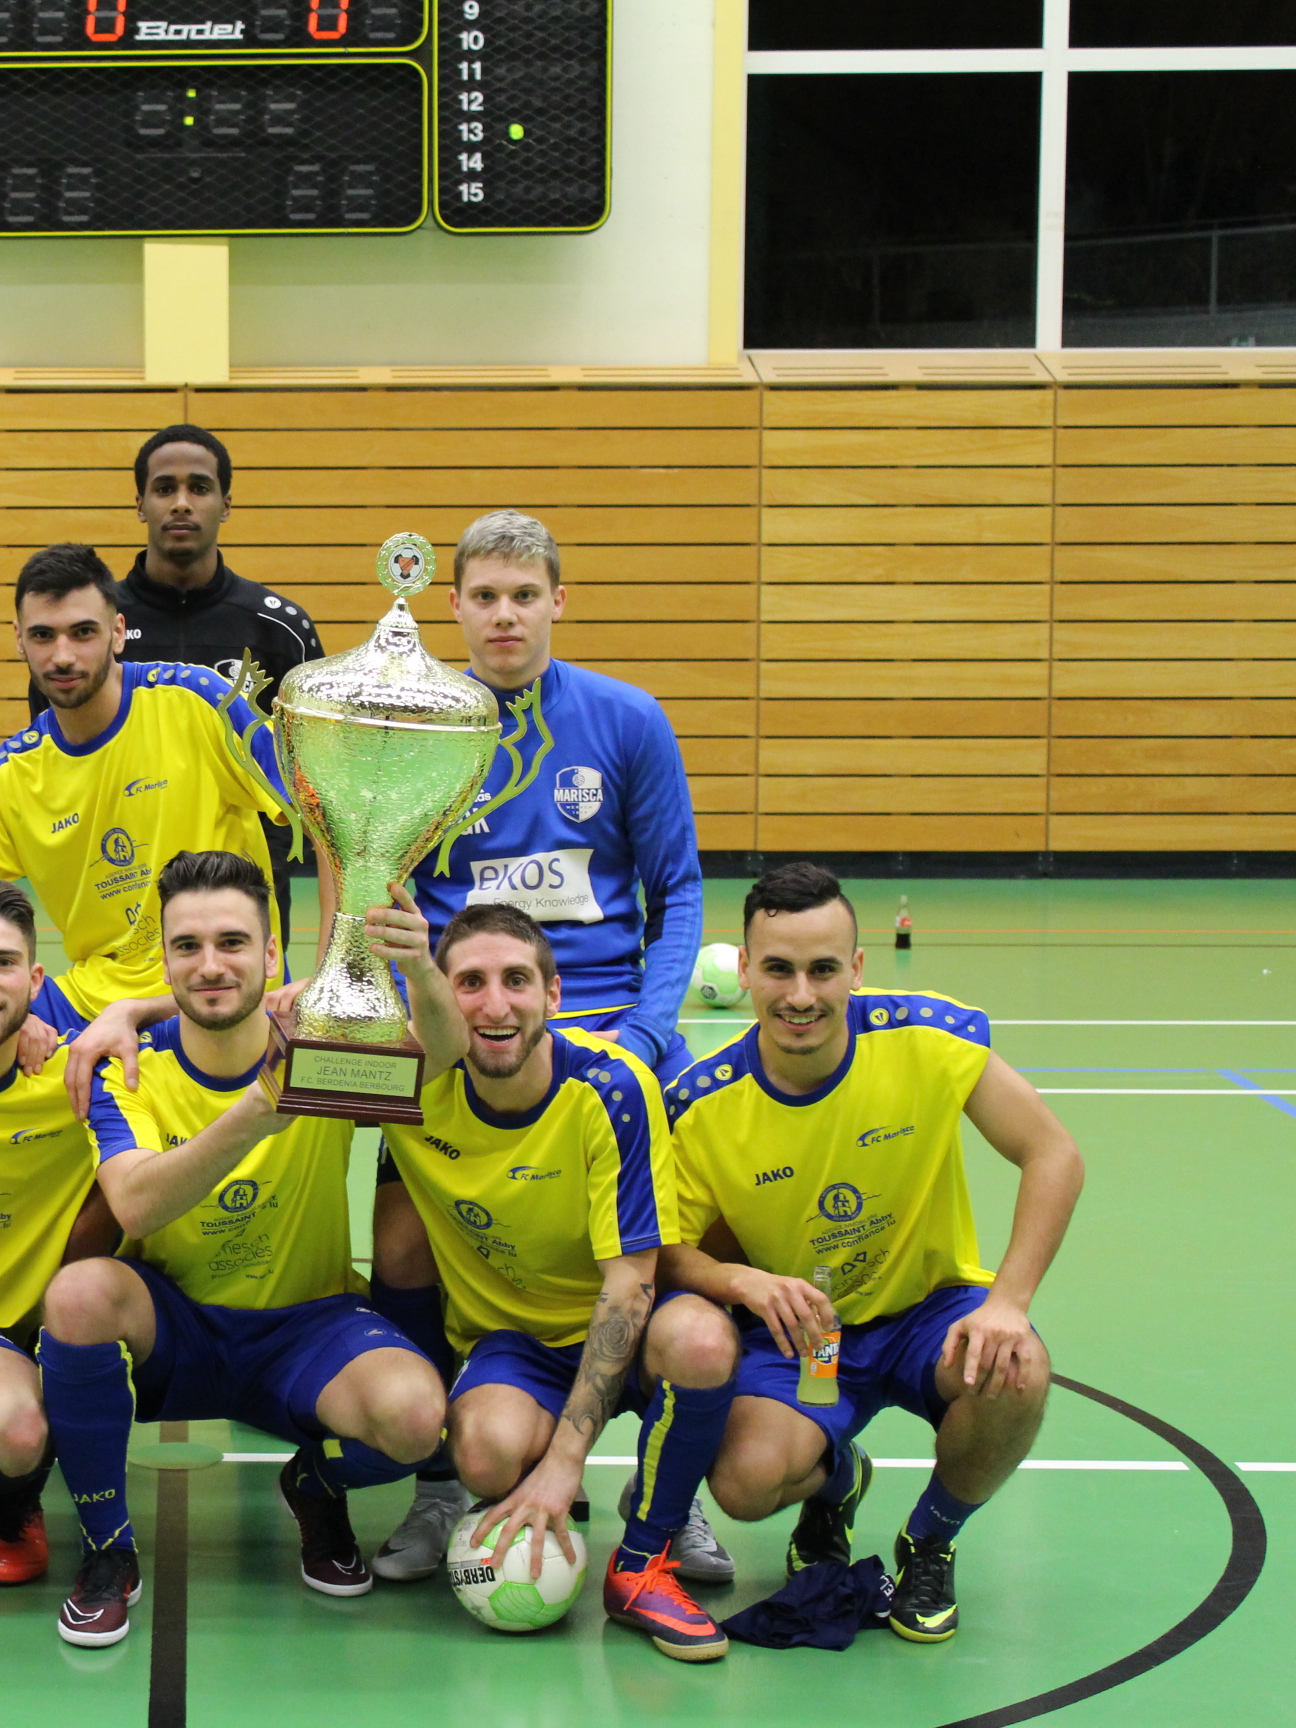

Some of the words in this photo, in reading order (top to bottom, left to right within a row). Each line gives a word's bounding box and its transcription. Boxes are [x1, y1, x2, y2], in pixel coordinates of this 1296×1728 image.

[462, 0, 480, 20] 9
[134, 20, 246, 41] Bodet
[458, 29, 485, 51] 10
[458, 60, 482, 81] 11
[458, 90, 484, 111] 12
[458, 121, 484, 142] 13
[457, 151, 485, 172] 14
[458, 182, 485, 202] 15
[554, 788, 604, 802] MARISCA
[51, 812, 80, 834] JAKO
[535, 894, 589, 908] Knowledge
[314, 1055, 363, 1066] CHALLENGE
[365, 1059, 397, 1069] INDOOR
[316, 1065, 347, 1077] JEAN
[350, 1068, 393, 1081] MANTZ
[317, 1077, 358, 1088] BERDENIA
[359, 1081, 405, 1092] BERBOURG
[424, 1135, 461, 1161] JAKO
[755, 1166, 795, 1186] JAKO
[200, 1211, 257, 1228] TOUSSAINT
[809, 1225, 866, 1246] TOUSSAINT
[869, 1212, 893, 1226] Abby
[73, 1488, 116, 1503] JAKO
